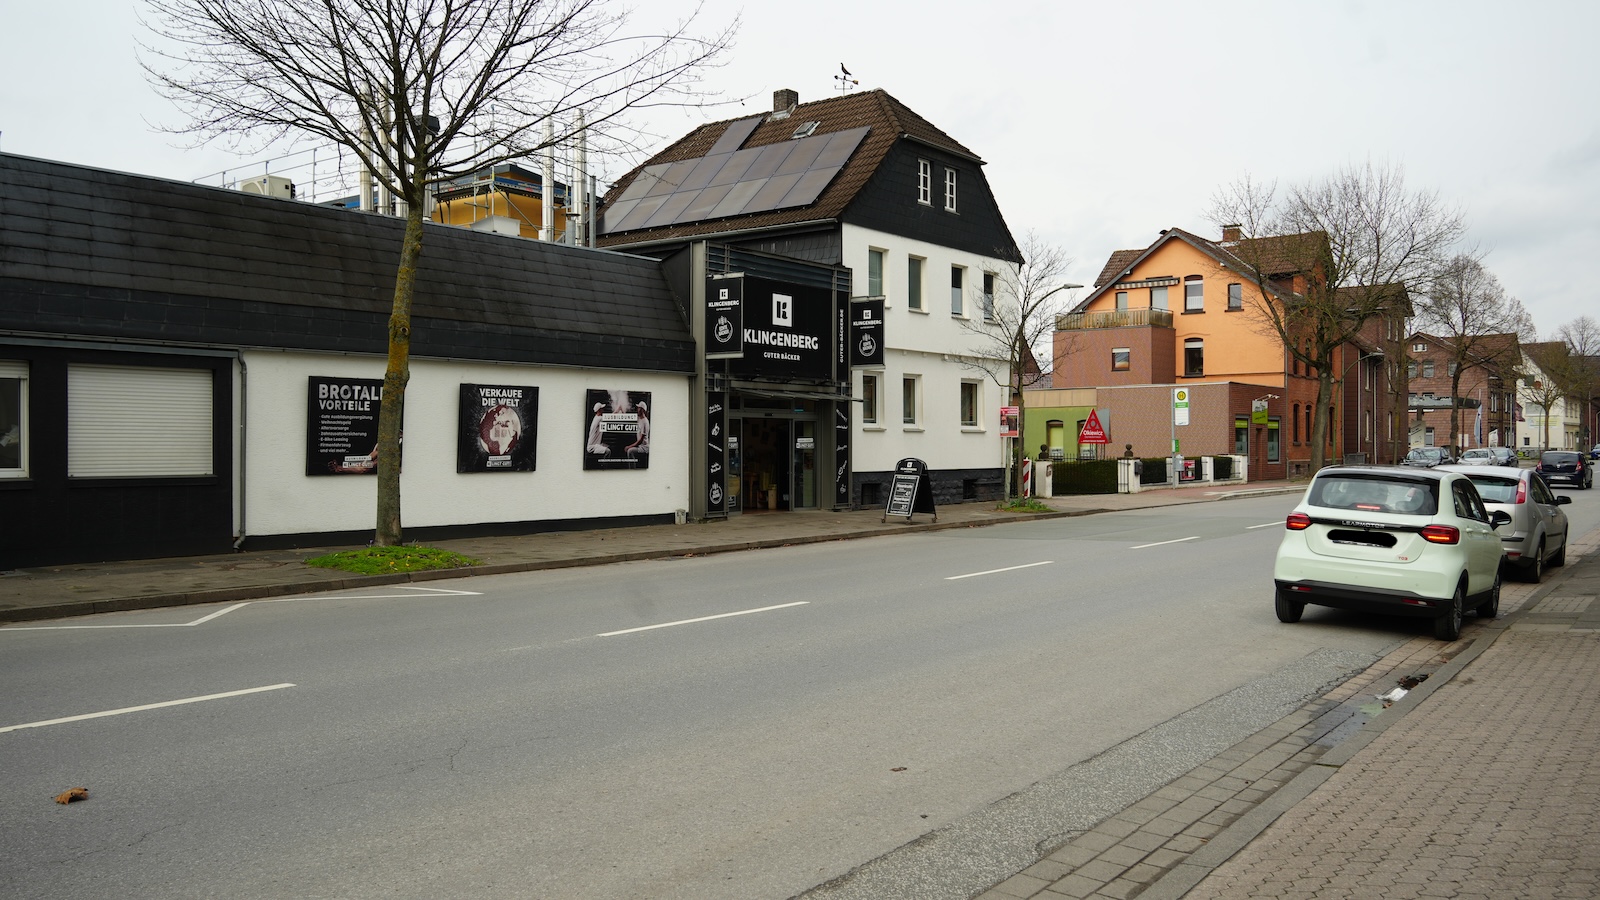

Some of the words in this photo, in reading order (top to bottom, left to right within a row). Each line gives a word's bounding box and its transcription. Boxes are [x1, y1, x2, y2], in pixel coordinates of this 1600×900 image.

[743, 328, 819, 350] KLINGENBERG
[763, 351, 780, 359] GUTER
[781, 352, 800, 361] BÄCKER
[319, 384, 383, 400] BROTAL
[479, 388, 523, 398] VERKAUFE
[319, 400, 371, 411] VORTEILE
[482, 398, 496, 406] DIE
[497, 398, 520, 407] WELT
[1342, 521, 1385, 529] LEAPMOTOR
